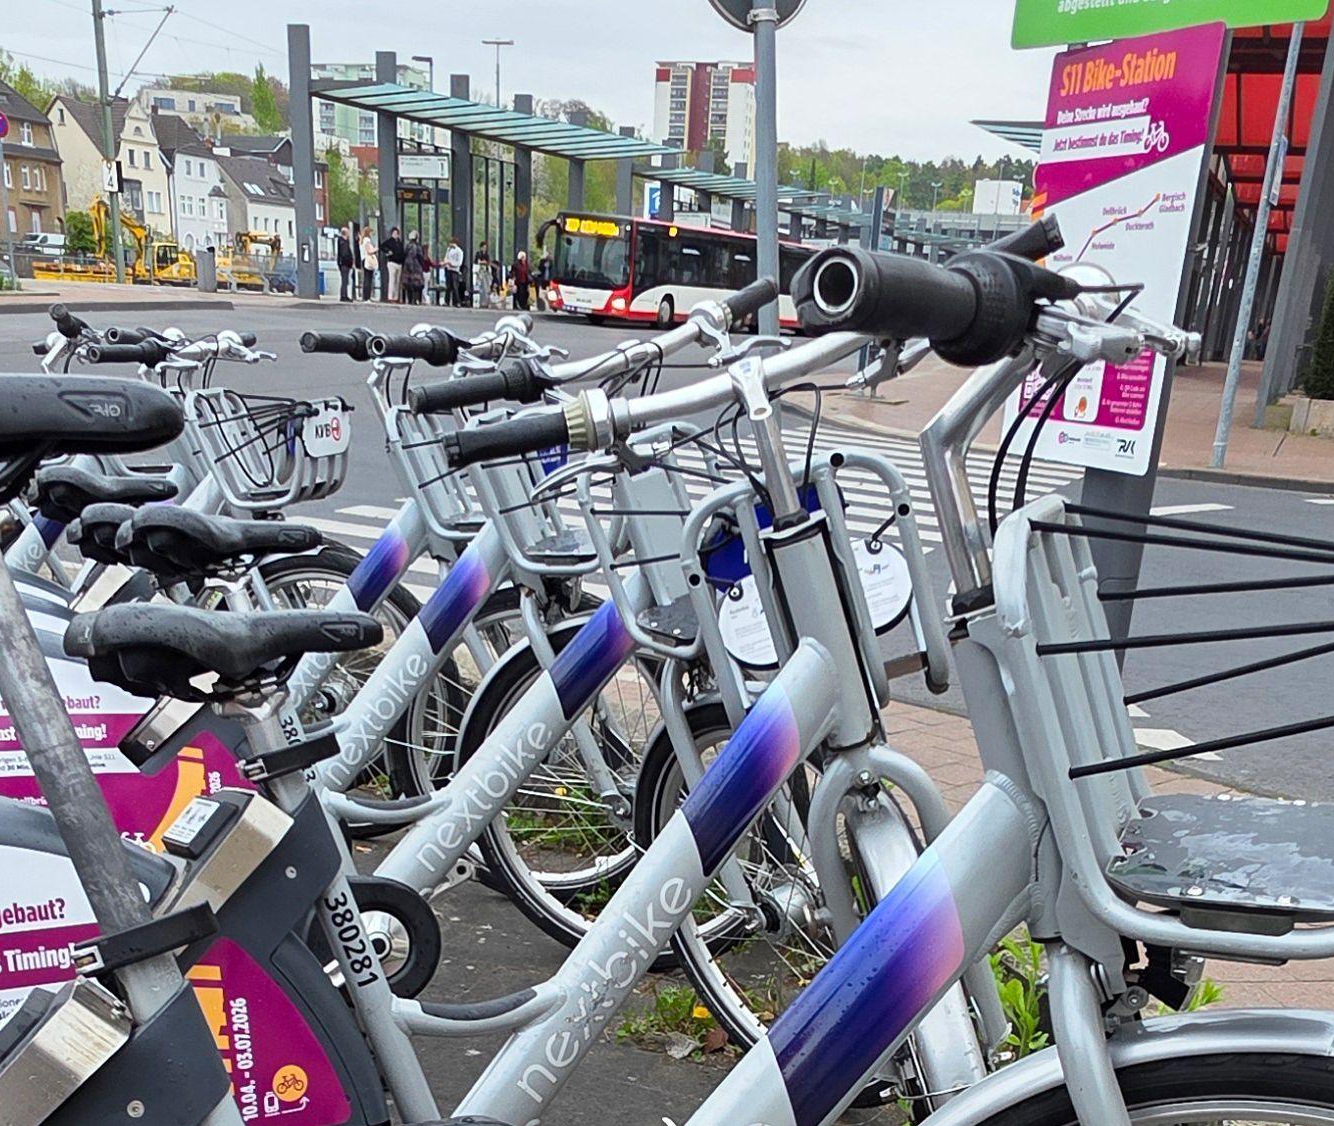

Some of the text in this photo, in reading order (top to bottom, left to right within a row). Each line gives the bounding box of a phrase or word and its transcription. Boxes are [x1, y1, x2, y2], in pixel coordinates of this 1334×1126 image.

[1060, 48, 1177, 96] S11 Bike-Station
[106, 175, 113, 188] 4
[62, 696, 100, 711] baut?
[293, 651, 330, 707] extb
[75, 723, 107, 742] ing!
[325, 652, 428, 786] nextbike
[417, 721, 550, 872] nextbike
[5, 942, 76, 970] Timing!
[324, 892, 378, 988] 380281
[516, 876, 692, 1104] nextbike
[229, 997, 254, 1070] 03.07.2026
[240, 1080, 258, 1122] 10.04.
